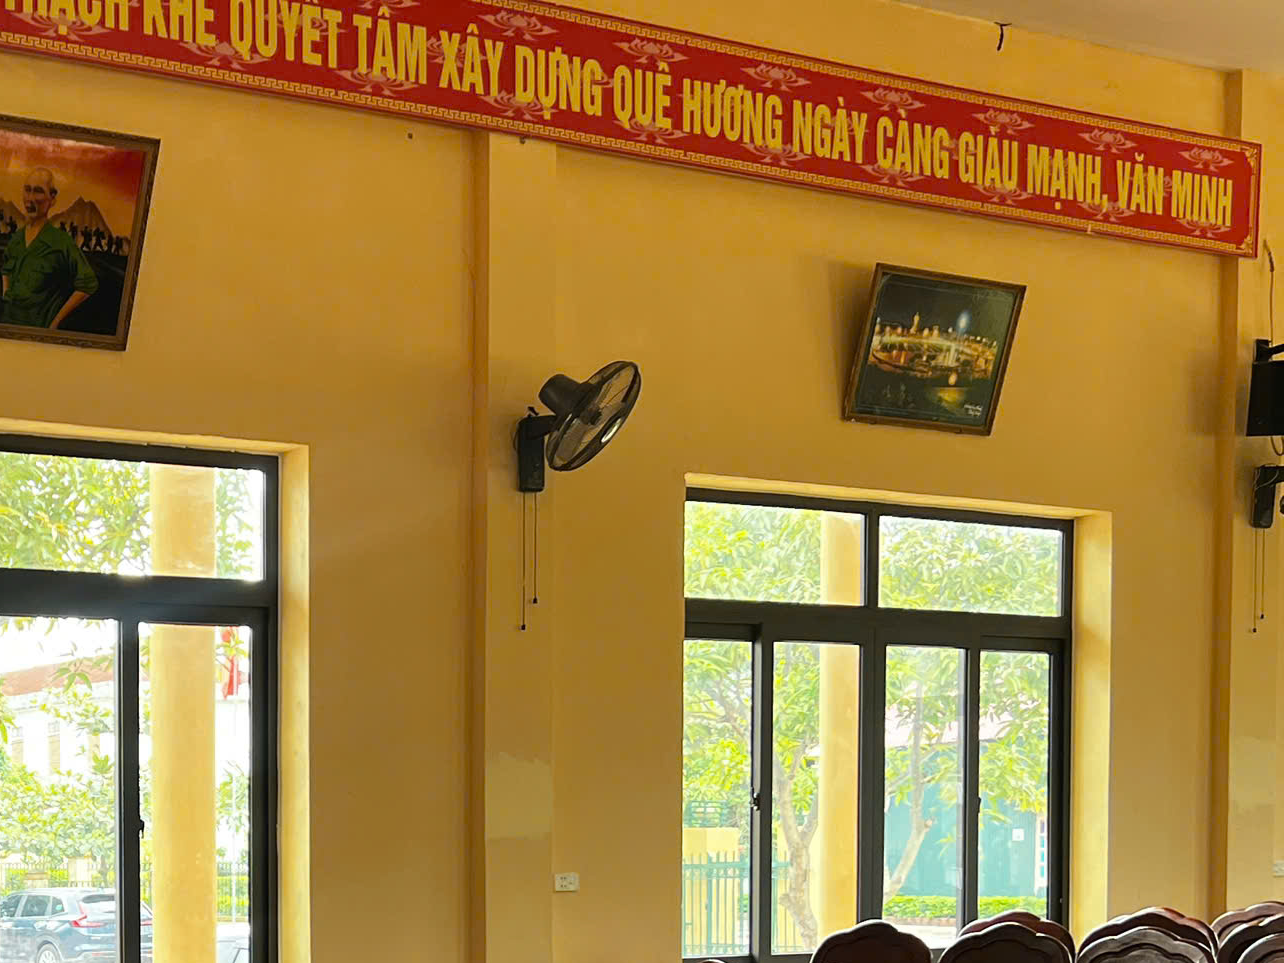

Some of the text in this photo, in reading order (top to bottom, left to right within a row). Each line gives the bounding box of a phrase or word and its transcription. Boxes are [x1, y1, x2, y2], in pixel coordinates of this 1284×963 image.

[353, 6, 427, 84] TÂM
[439, 23, 504, 97] XÂY
[515, 45, 603, 120] DỰNG
[613, 62, 672, 129] QUÊ
[682, 78, 783, 152] HƯƠNG
[793, 97, 868, 164] NGÀY
[877, 107, 950, 179] CÀNG
[1027, 144, 1108, 213] MẠNH,
[1117, 152, 1164, 215] VĂN
[1171, 169, 1233, 226] MINH
